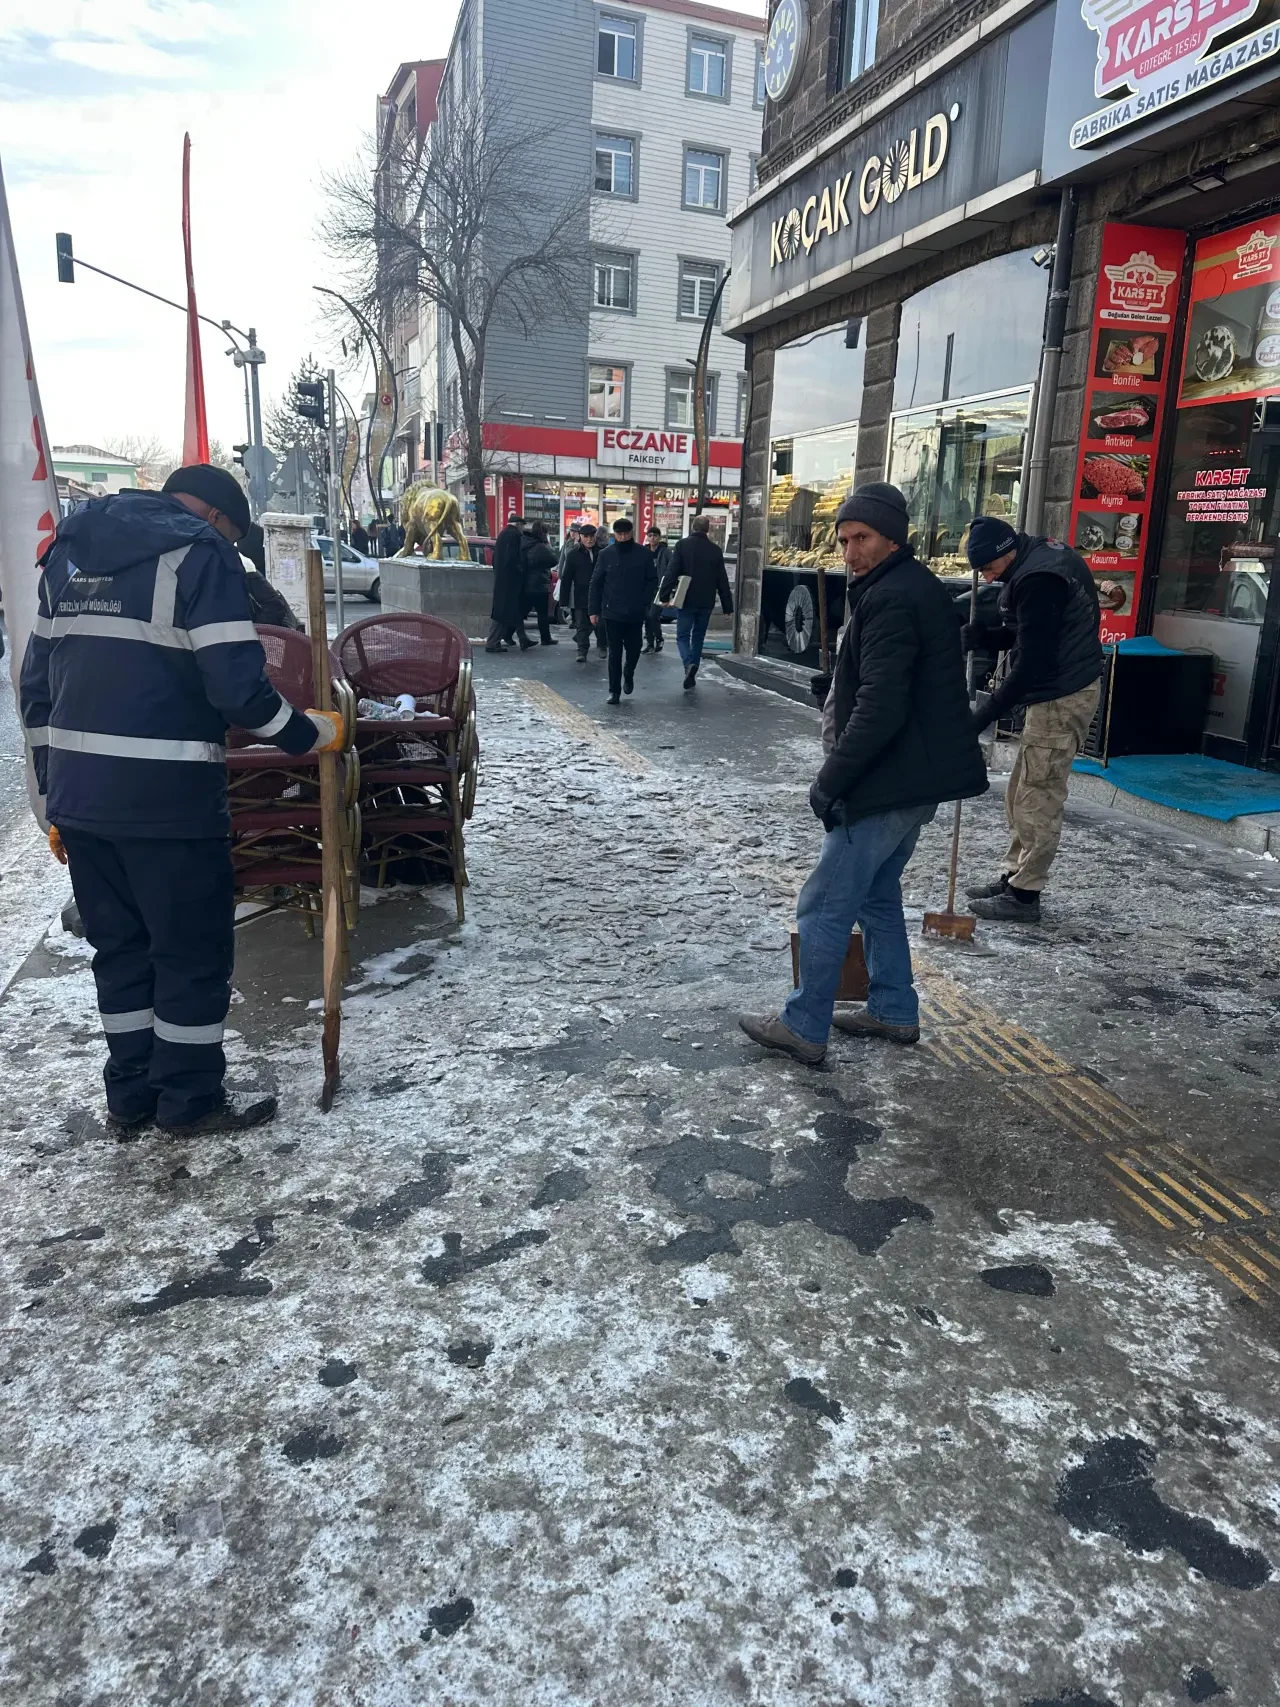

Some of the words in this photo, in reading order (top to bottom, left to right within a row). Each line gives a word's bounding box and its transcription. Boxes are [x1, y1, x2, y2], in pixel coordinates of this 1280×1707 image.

[1140, 48, 1173, 75] ENTEGRE
[1073, 103, 1131, 145] FABRİKA
[1136, 79, 1180, 114] SATIŞ
[1185, 28, 1280, 92] MAĞAZASI
[770, 170, 853, 268] KOÇAK
[859, 112, 948, 215] GOLD
[1107, 311, 1129, 319] Doğudan
[1113, 373, 1140, 386] Bonfile
[603, 429, 687, 453] ECZANE
[1105, 435, 1133, 447] Antrikot
[1101, 494, 1123, 508] Kıyma
[1177, 490, 1207, 500] FABRİKA
[1207, 490, 1227, 501] SATIŞ
[1226, 487, 1266, 499] MAĞAZASI
[1188, 502, 1216, 511] TOPTAN
[1186, 512, 1227, 522] PERAKENDE
[1227, 512, 1249, 524] SATIŞ
